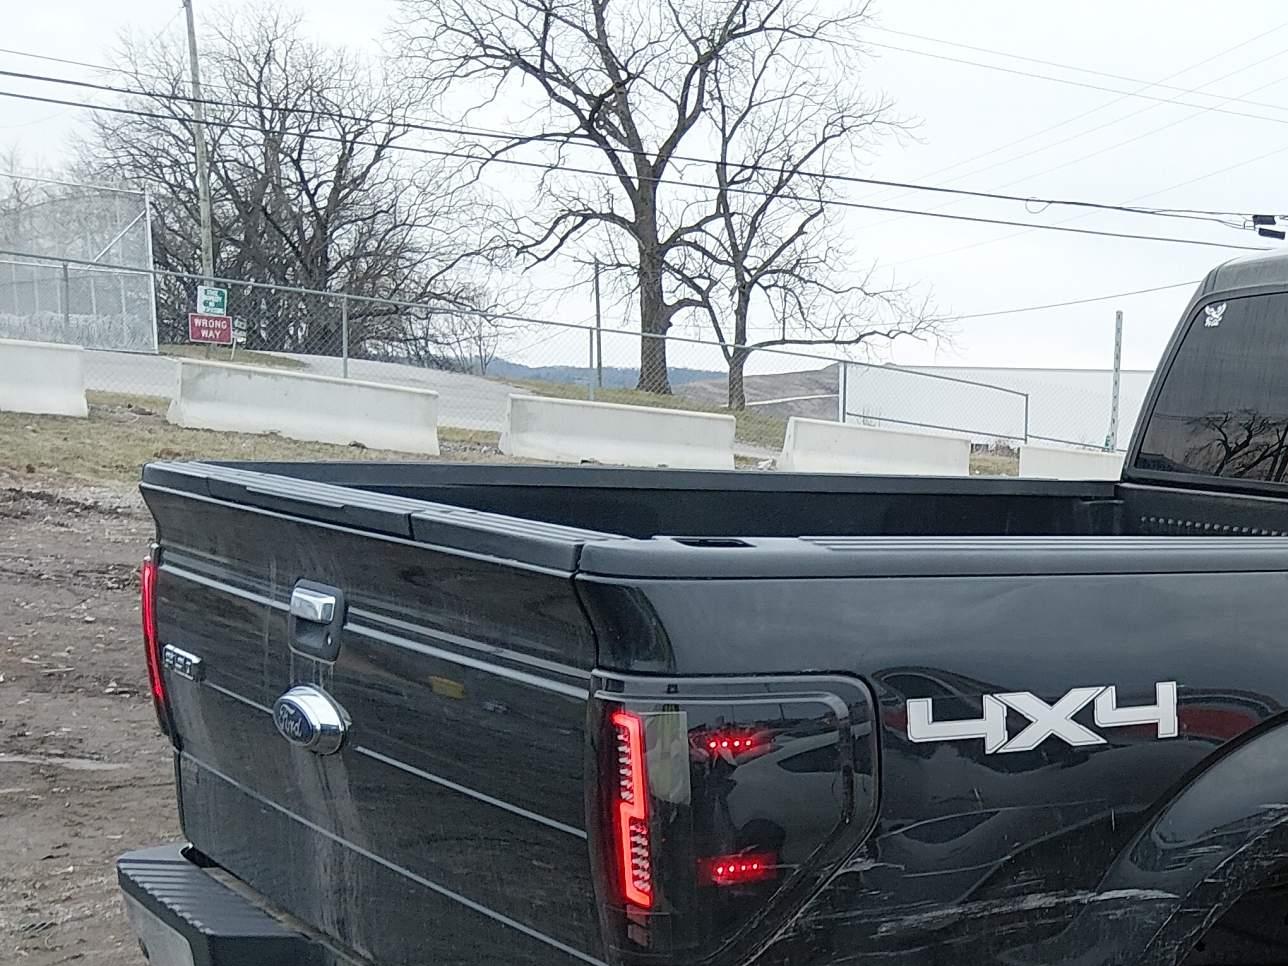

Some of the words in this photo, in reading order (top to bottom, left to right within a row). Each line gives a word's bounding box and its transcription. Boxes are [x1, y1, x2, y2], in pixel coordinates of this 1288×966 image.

[193, 318, 227, 329] WRONG
[200, 329, 221, 339] WAY
[278, 703, 304, 738] Ford
